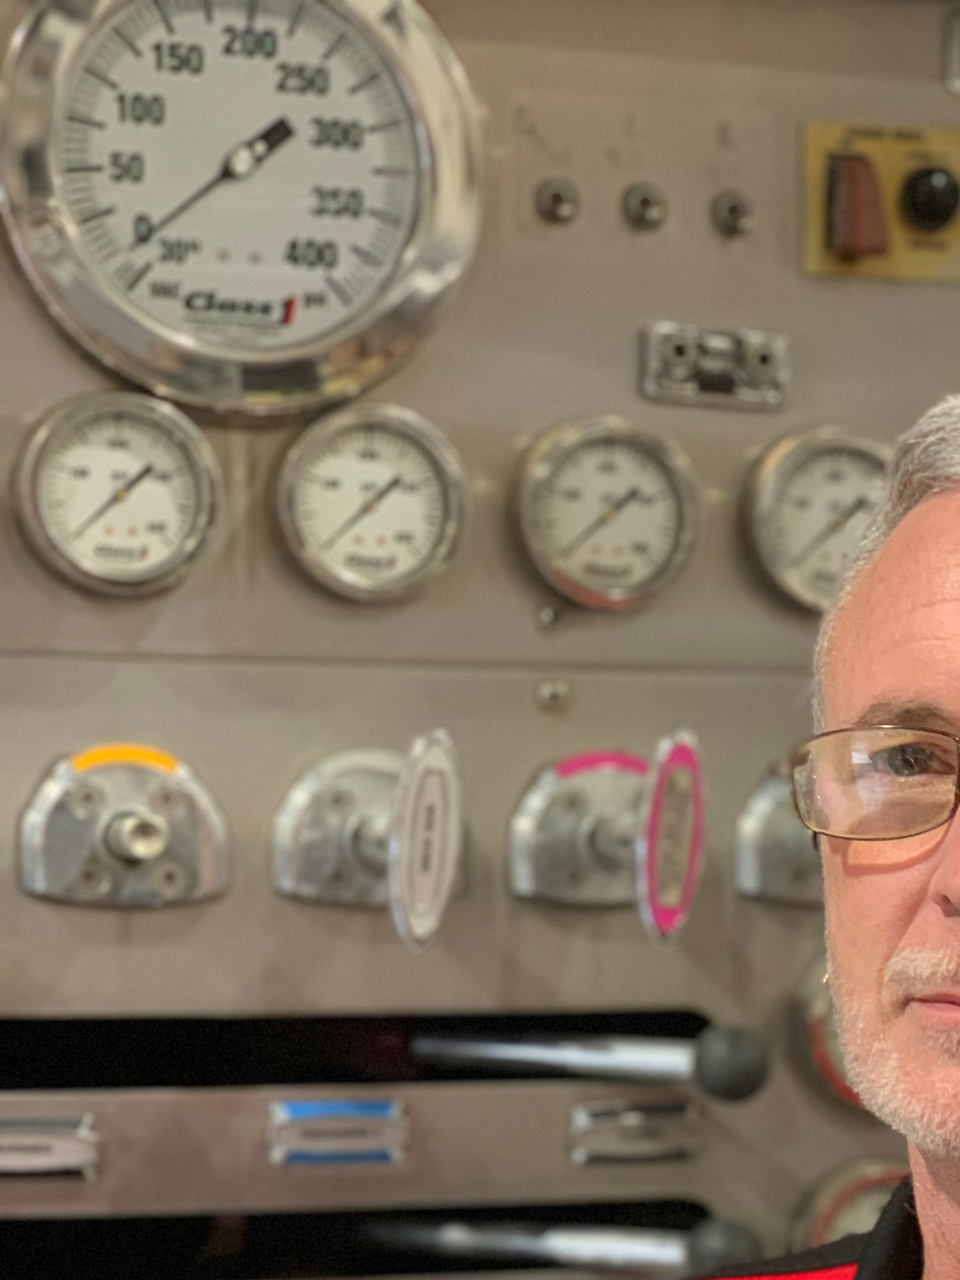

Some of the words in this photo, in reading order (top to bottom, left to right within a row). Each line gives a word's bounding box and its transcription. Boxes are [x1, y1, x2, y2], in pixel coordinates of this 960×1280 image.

[153, 42, 204, 74] 150
[222, 27, 278, 58] 200
[276, 64, 331, 95] 250
[116, 94, 165, 125] 100
[310, 119, 364, 149] 300
[110, 153, 144, 183] 50
[311, 187, 364, 218] 350
[133, 213, 153, 243] 0
[284, 238, 338, 268] 400
